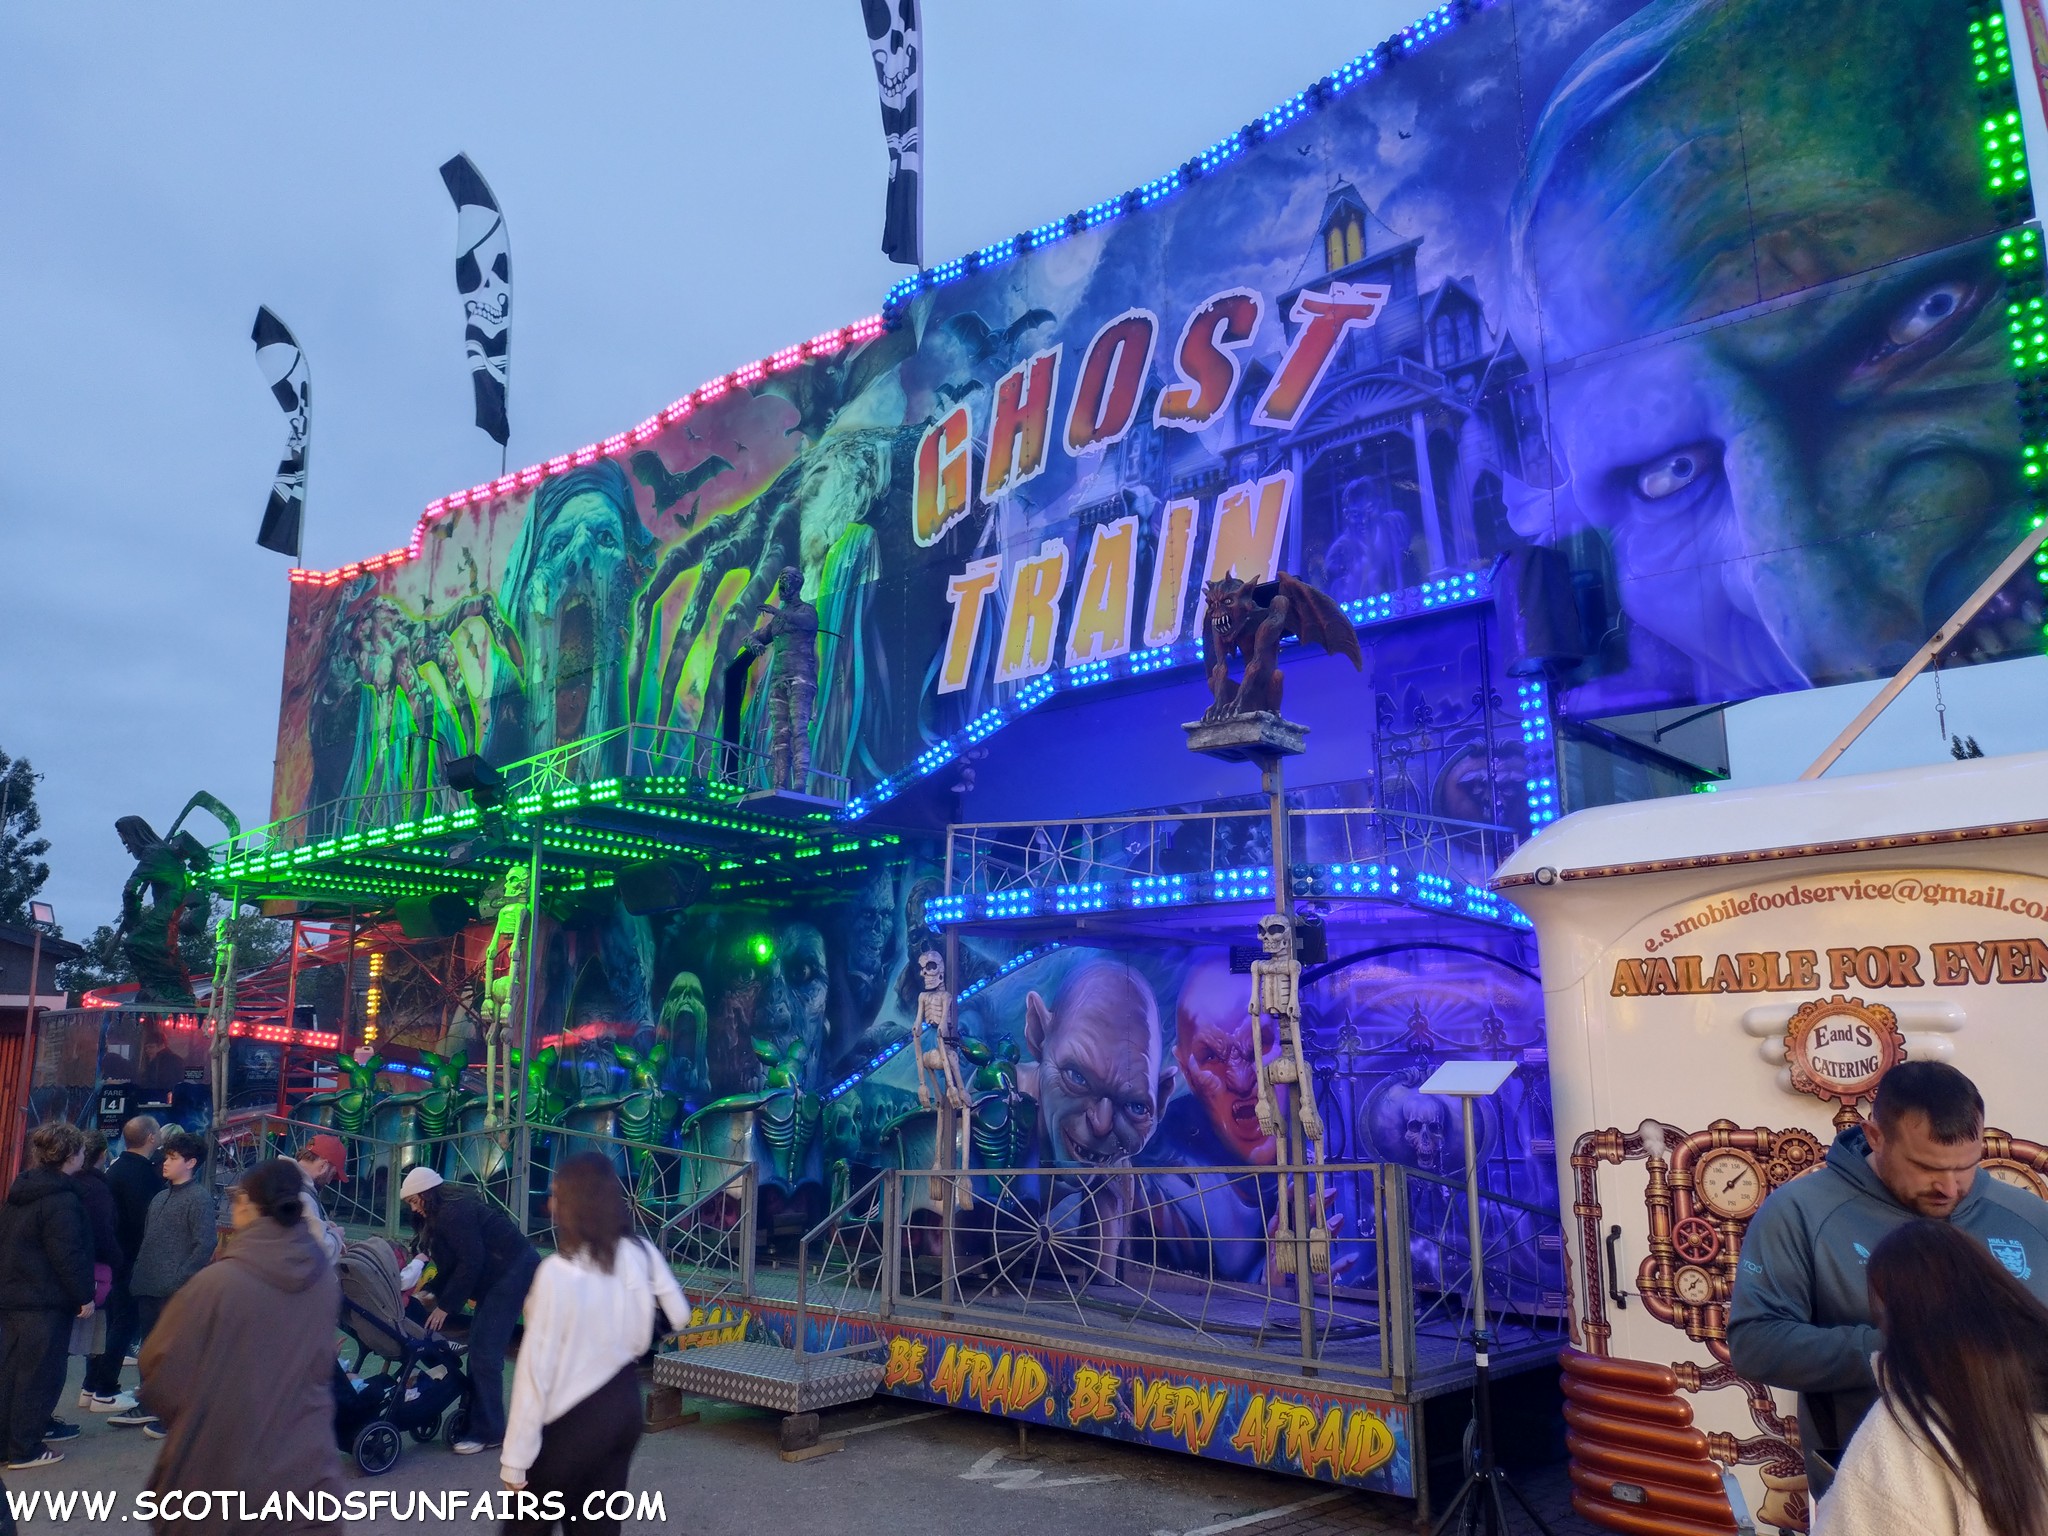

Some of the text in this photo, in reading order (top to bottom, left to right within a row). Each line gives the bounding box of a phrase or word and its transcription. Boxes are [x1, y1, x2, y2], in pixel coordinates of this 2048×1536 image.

[913, 282, 1391, 547] GHOST
[937, 470, 1295, 695] TRAIN
[1644, 878, 2048, 953] e.s.mobilefoodservice@gmail.co
[1610, 949, 1820, 997] AVAILABLE
[1826, 945, 1925, 989] FOR
[1813, 1024, 1873, 1050] E and S
[1811, 1055, 1879, 1079] CATERING
[108, 1099, 117, 1110] 4
[677, 1304, 753, 1352] EAM
[884, 1335, 926, 1389] BE
[1068, 1366, 1122, 1425] BE
[1132, 1377, 1227, 1453] VERY
[1230, 1395, 1397, 1480] AFRAID
